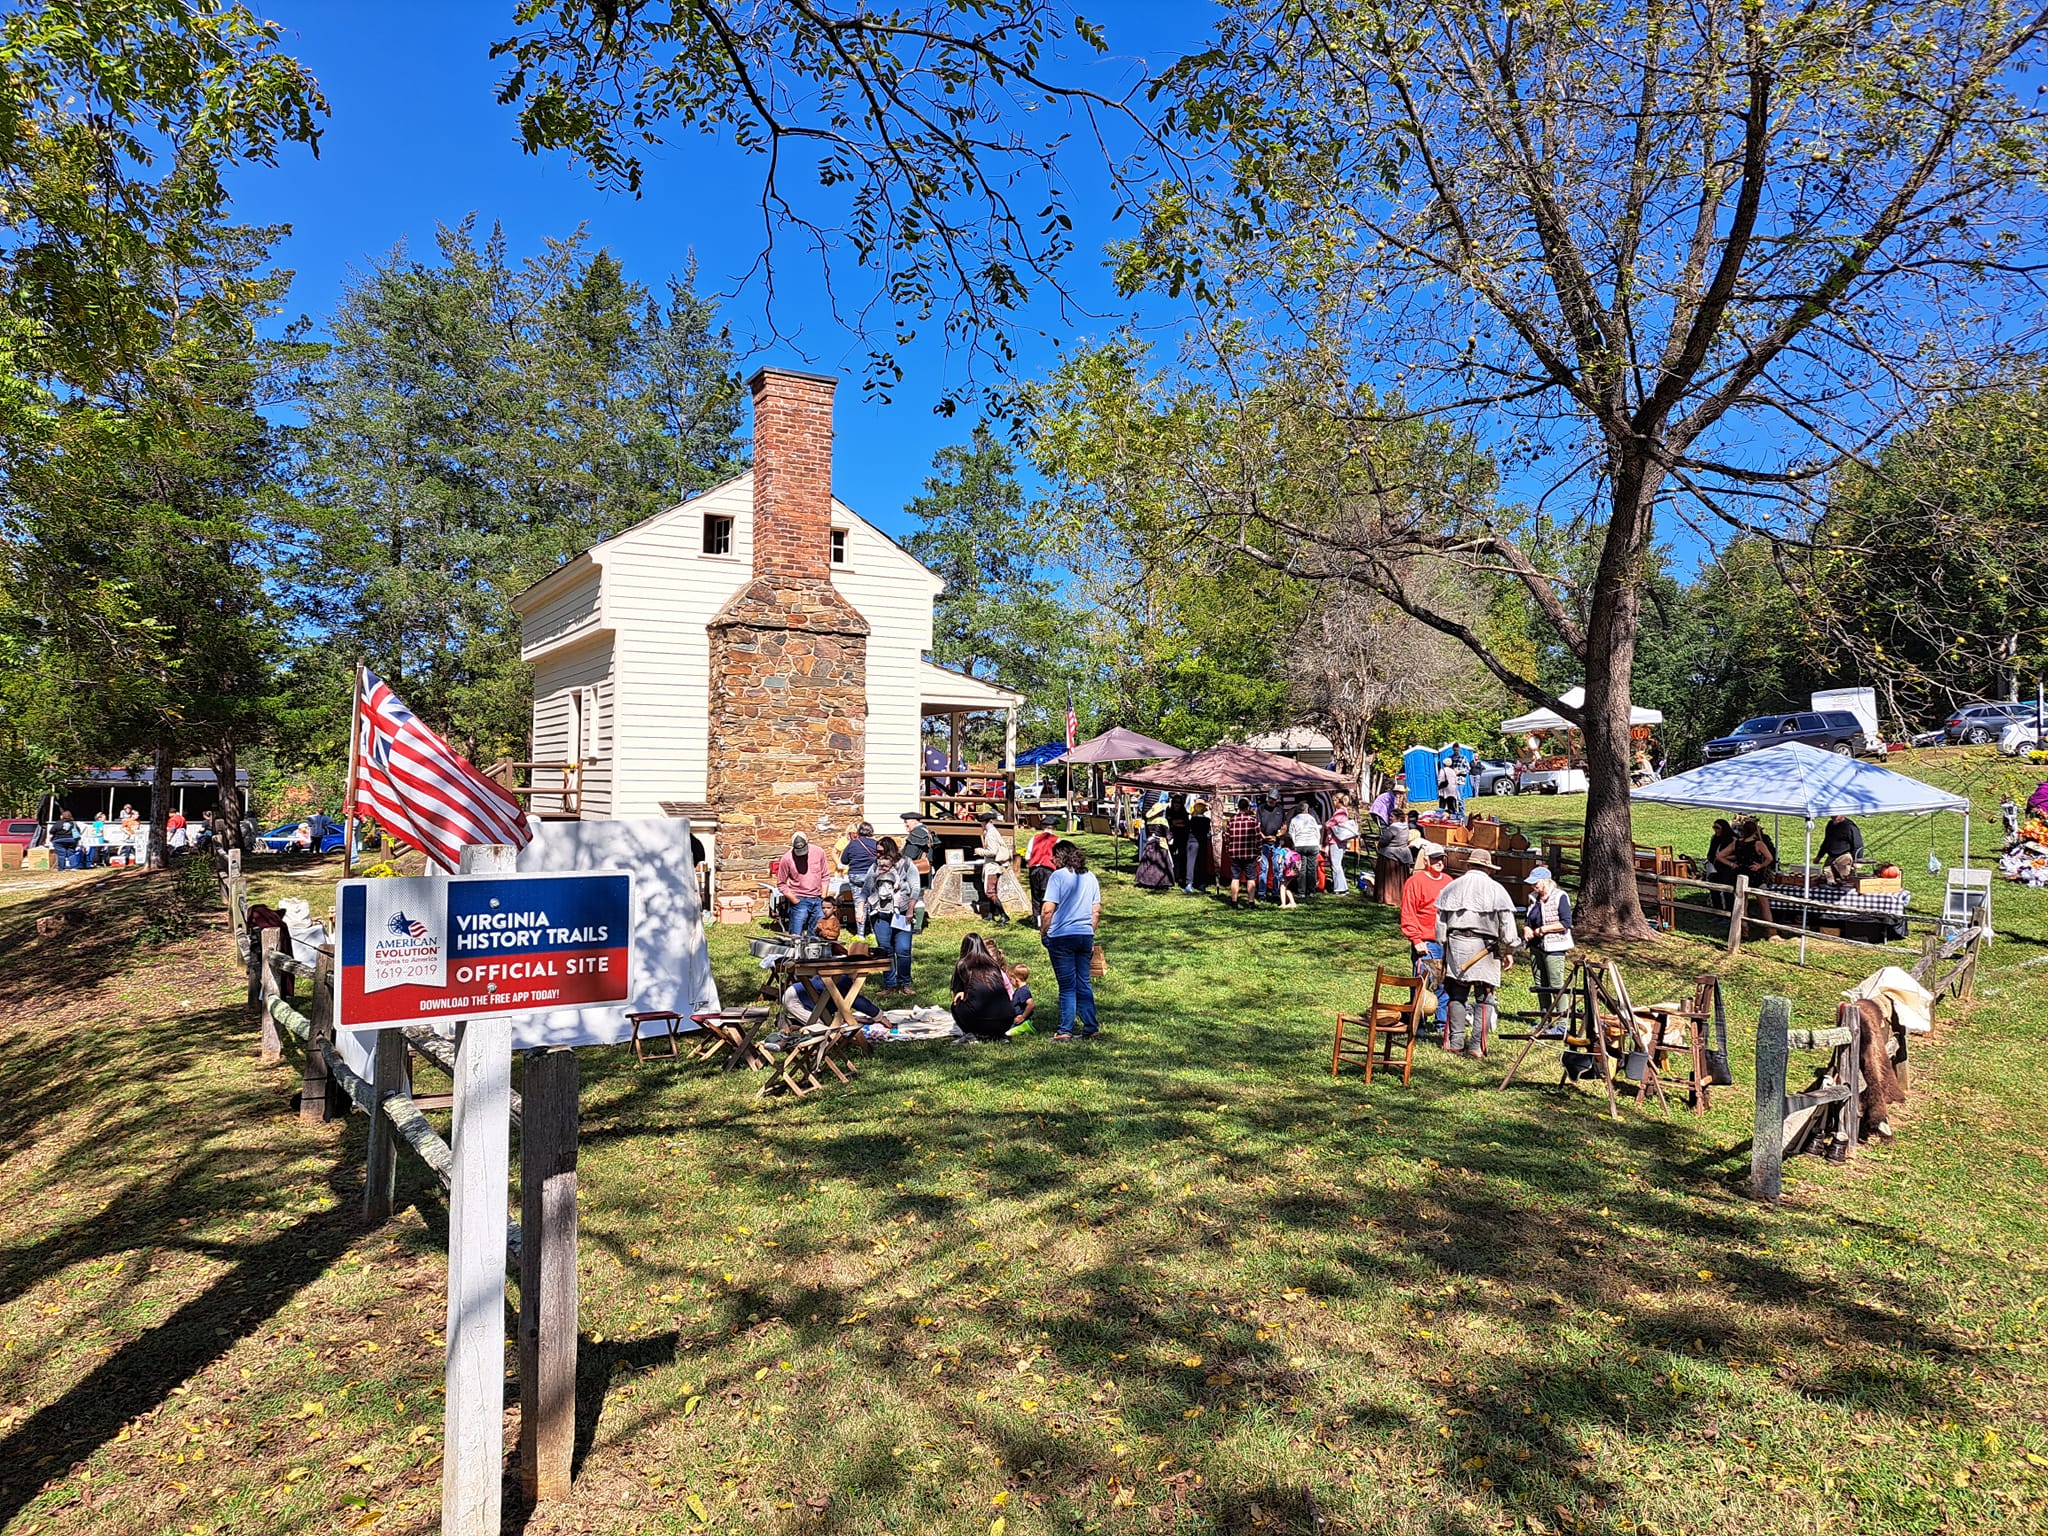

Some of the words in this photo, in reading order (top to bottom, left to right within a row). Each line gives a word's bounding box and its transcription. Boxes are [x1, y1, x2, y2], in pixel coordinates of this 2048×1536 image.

[456, 911, 550, 931] VIRGINIA
[376, 937, 438, 949] AMERICAN
[457, 929, 542, 950] HISTORY
[546, 926, 608, 944] TRAILS
[376, 964, 438, 979] 1619-2019
[456, 960, 558, 983] OFFICIAL
[566, 957, 609, 975] SITE
[420, 997, 469, 1011] DOWNLOAD
[471, 995, 488, 1006] THE
[490, 993, 511, 1004] FREE
[512, 991, 529, 1002] APP
[531, 989, 560, 1000] TODAY!
